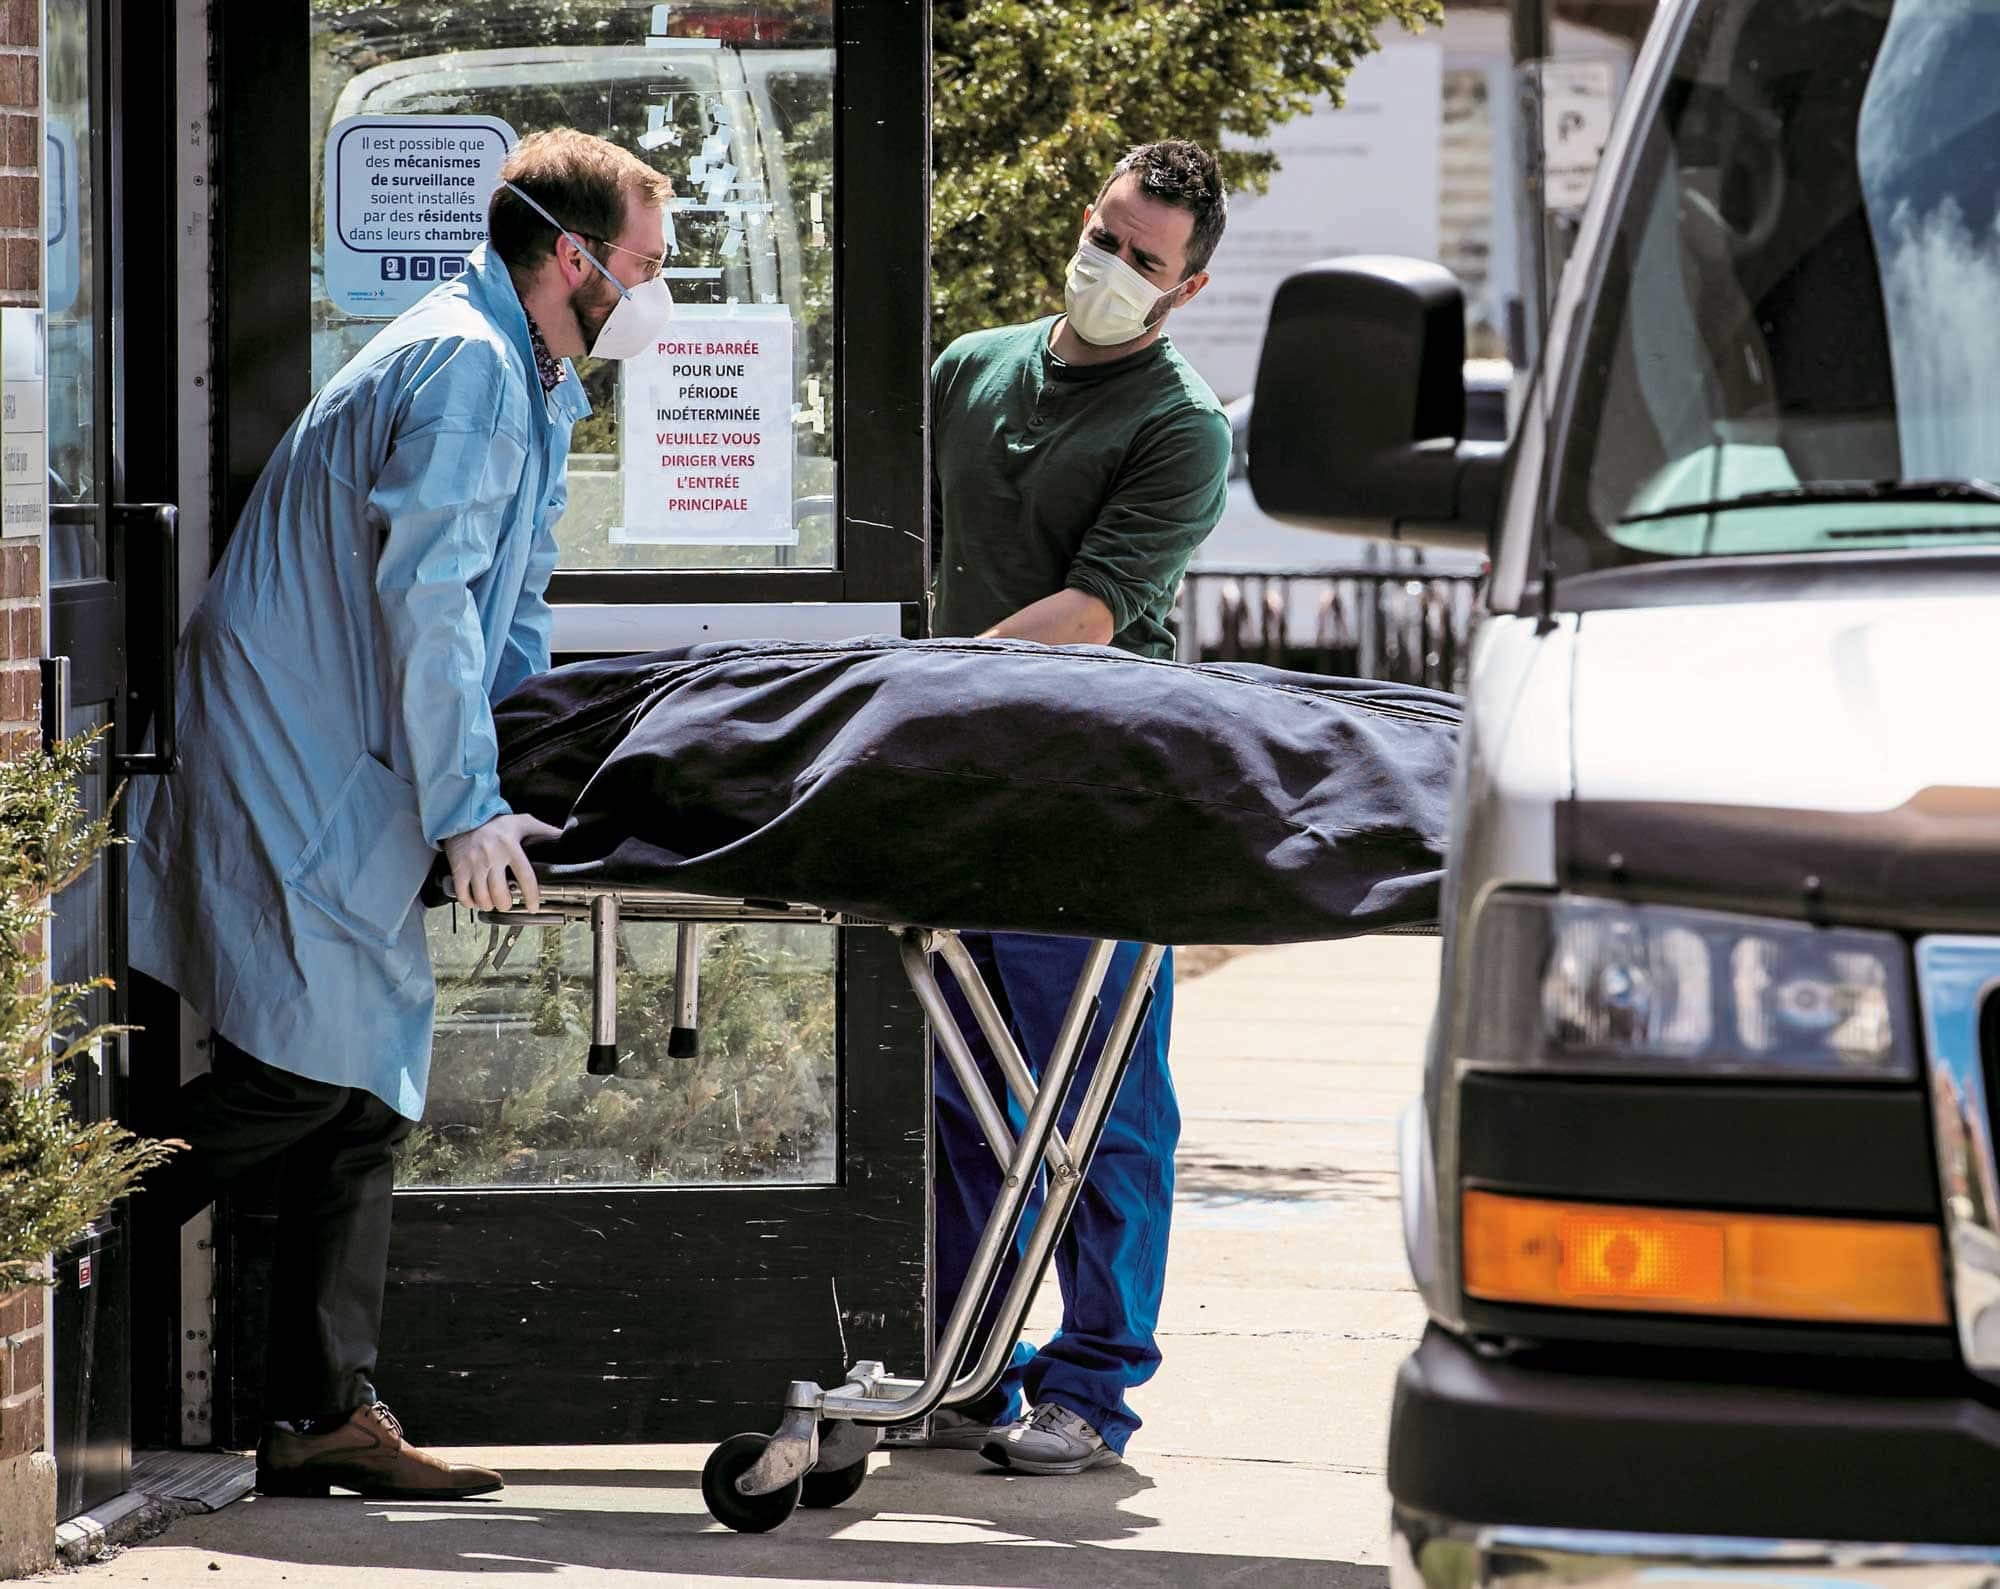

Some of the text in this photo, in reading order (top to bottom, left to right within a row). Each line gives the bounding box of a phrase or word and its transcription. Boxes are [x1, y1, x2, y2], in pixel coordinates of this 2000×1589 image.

[362, 137, 485, 152] Il est possible que
[365, 154, 481, 168] des mécanismes
[371, 174, 475, 187] de surveillance
[370, 192, 476, 205] soient installés
[363, 208, 483, 225] par des résidents
[349, 228, 383, 241] dans
[387, 228, 421, 241] leurs
[658, 340, 759, 355] PORTE BARRÉE
[672, 365, 745, 377] POUR UNE
[679, 384, 738, 399] PÉRIODE
[657, 406, 761, 421] INDÉTERMINÉE
[656, 433, 761, 445] VEUILLEZ VOUS
[661, 455, 755, 467] DIRIGER VERS
[677, 474, 740, 489] L'ENTRÉE
[669, 499, 748, 511] PRINCIPALE
